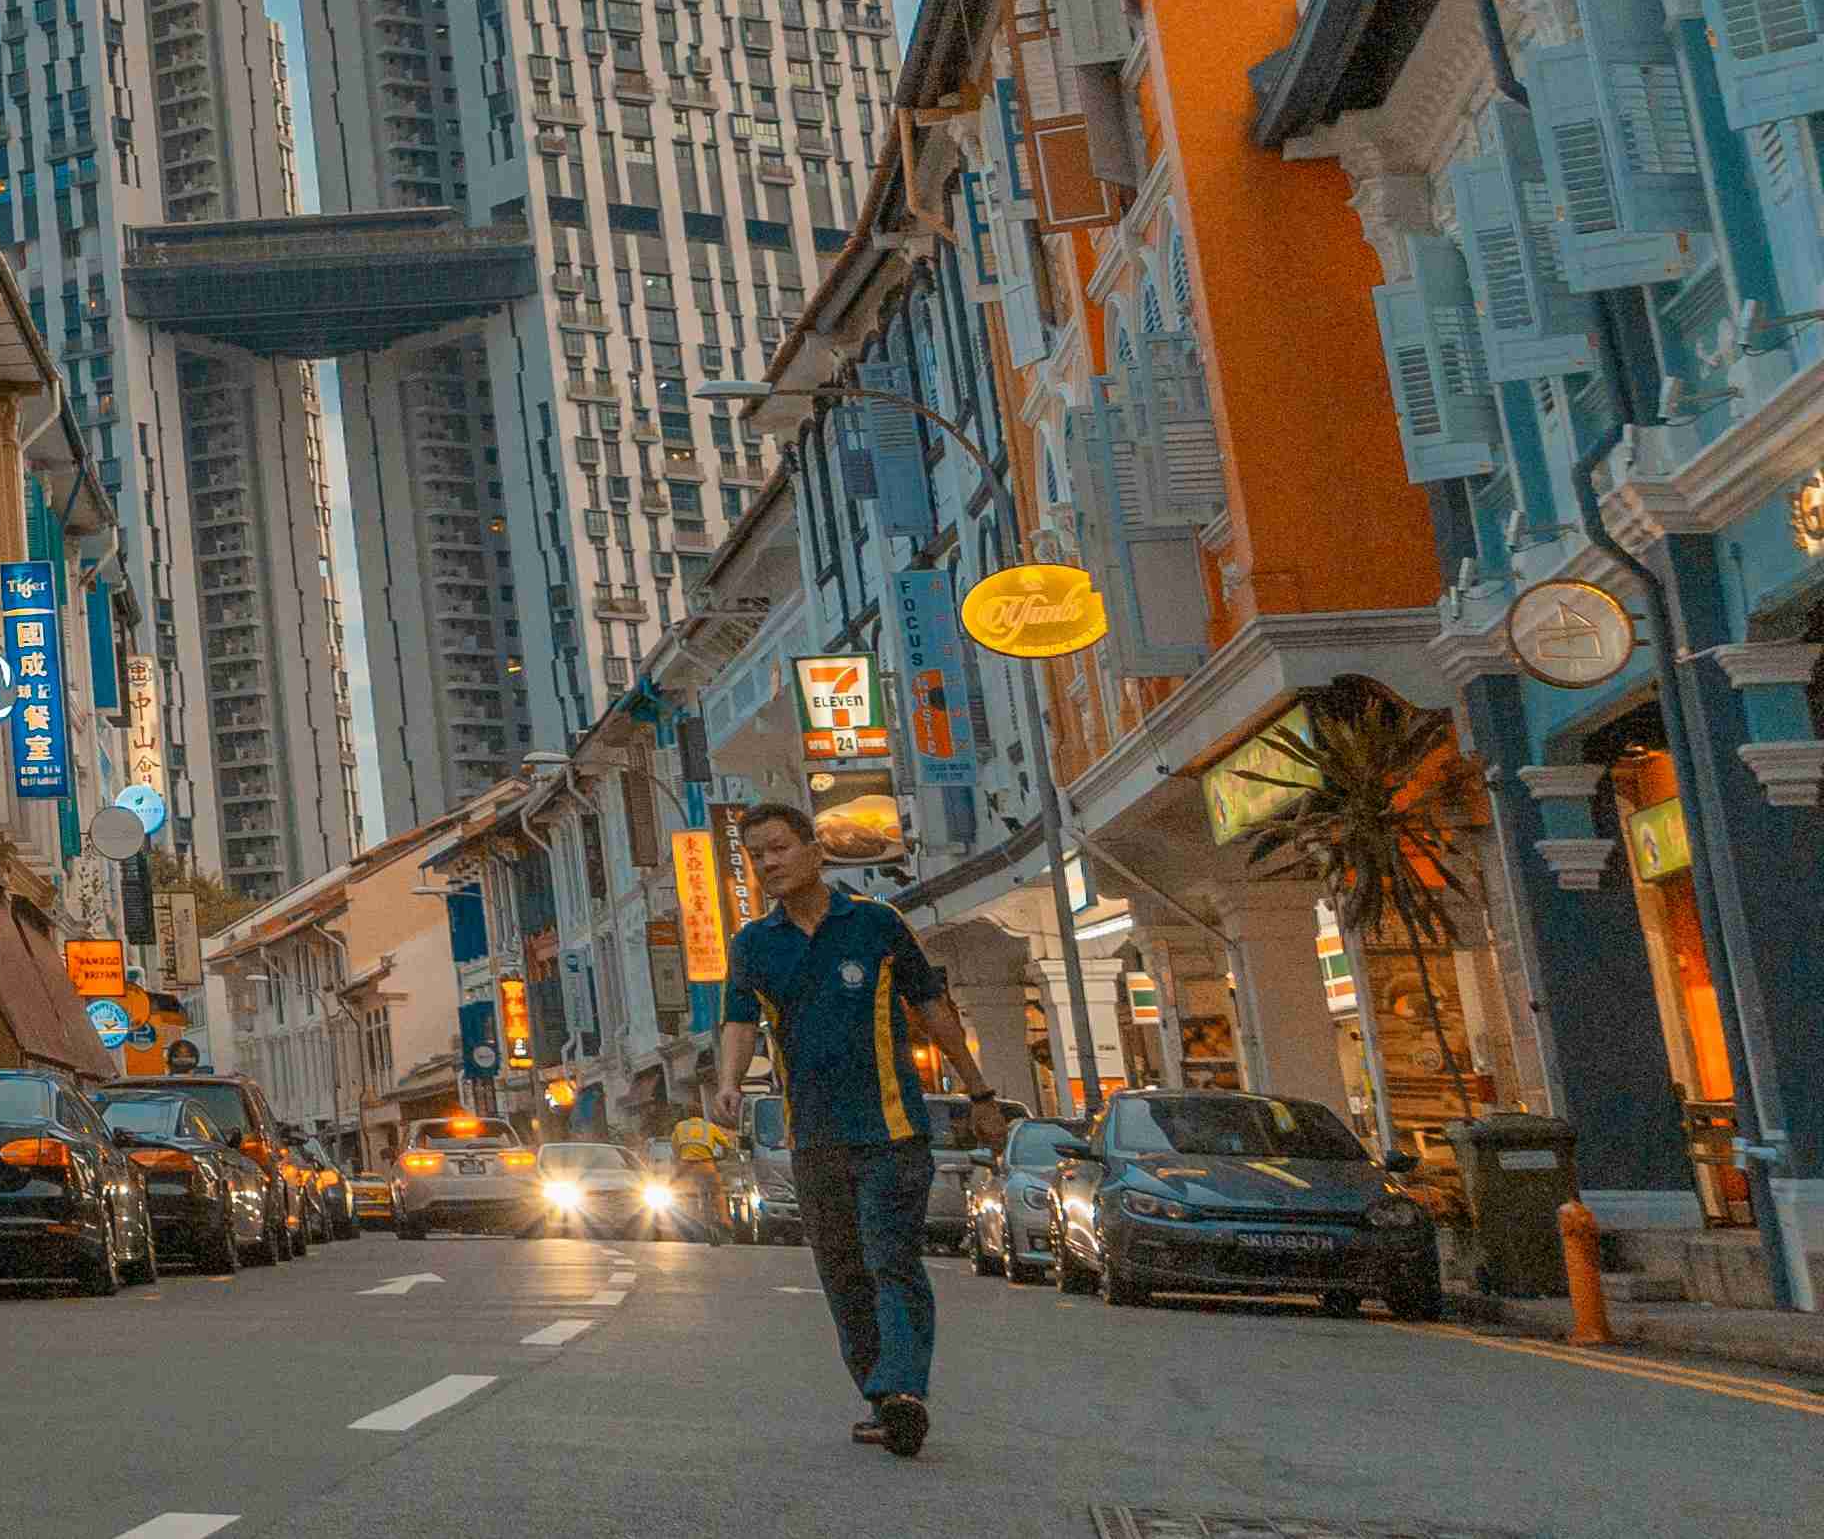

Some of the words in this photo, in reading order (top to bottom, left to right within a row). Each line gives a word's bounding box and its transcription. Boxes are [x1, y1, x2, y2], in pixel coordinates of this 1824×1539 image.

[6, 578, 47, 598] Tiger
[900, 581, 923, 666] FOCUS
[836, 737, 854, 751] 24
